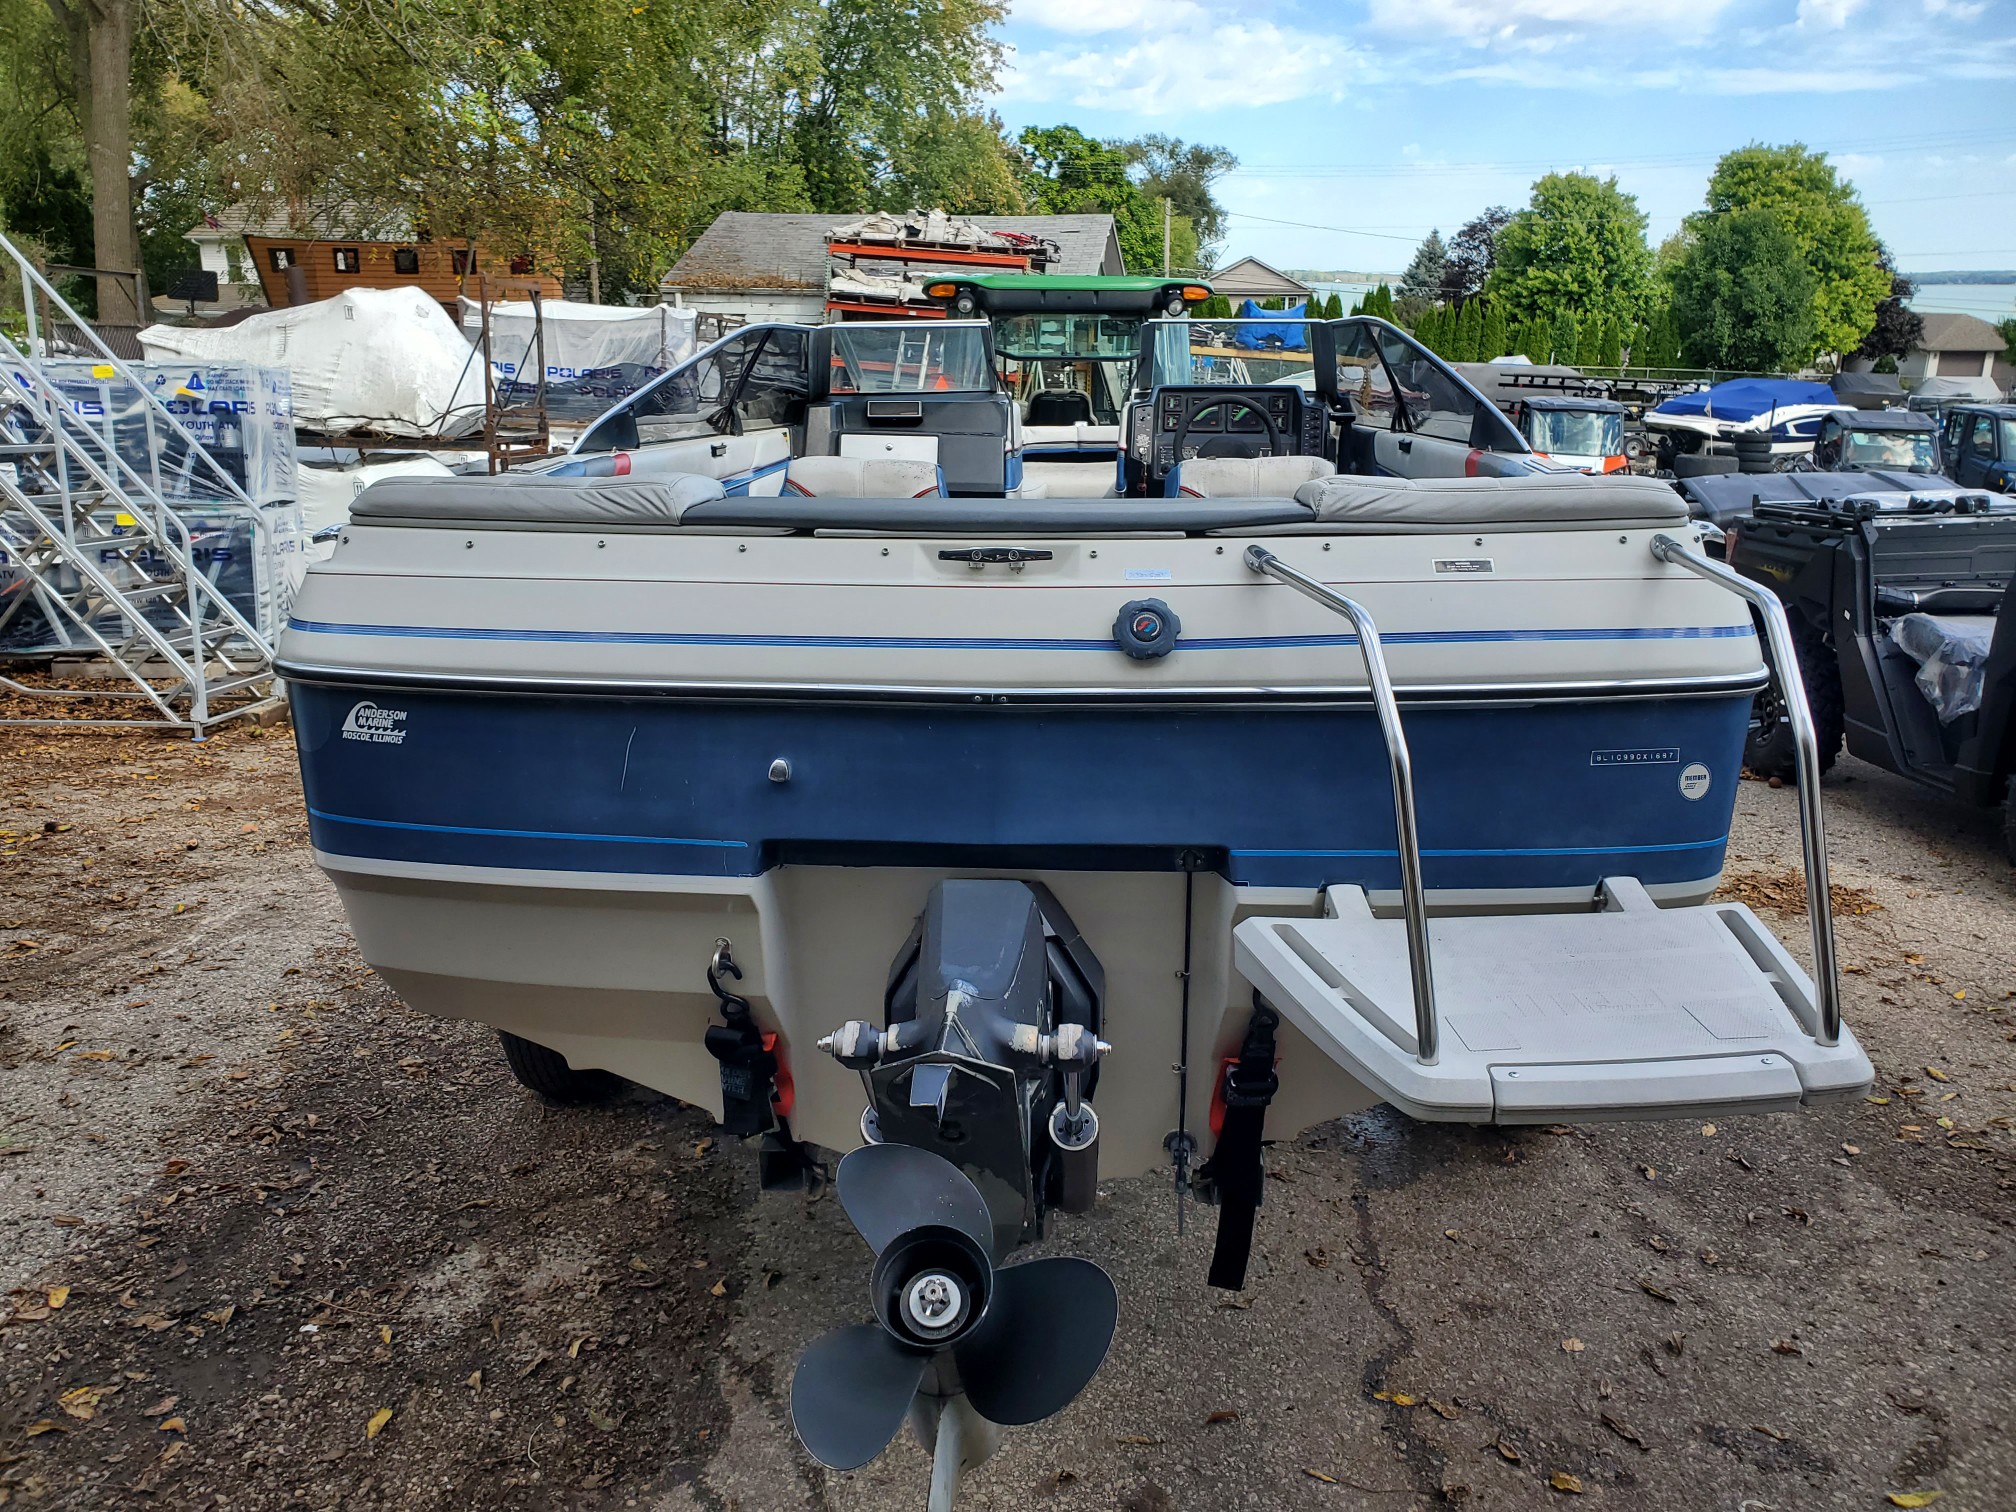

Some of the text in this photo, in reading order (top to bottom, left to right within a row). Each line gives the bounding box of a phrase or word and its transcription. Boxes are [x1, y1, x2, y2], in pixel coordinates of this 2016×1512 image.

[547, 366, 623, 379] POLARIS
[180, 421, 239, 430] YOUTH ATV
[101, 547, 233, 563] POLRIS
[358, 708, 407, 720] ANDERSON
[358, 717, 394, 728] MARINE
[342, 731, 404, 744] ROSCOE, ILLINOIS
